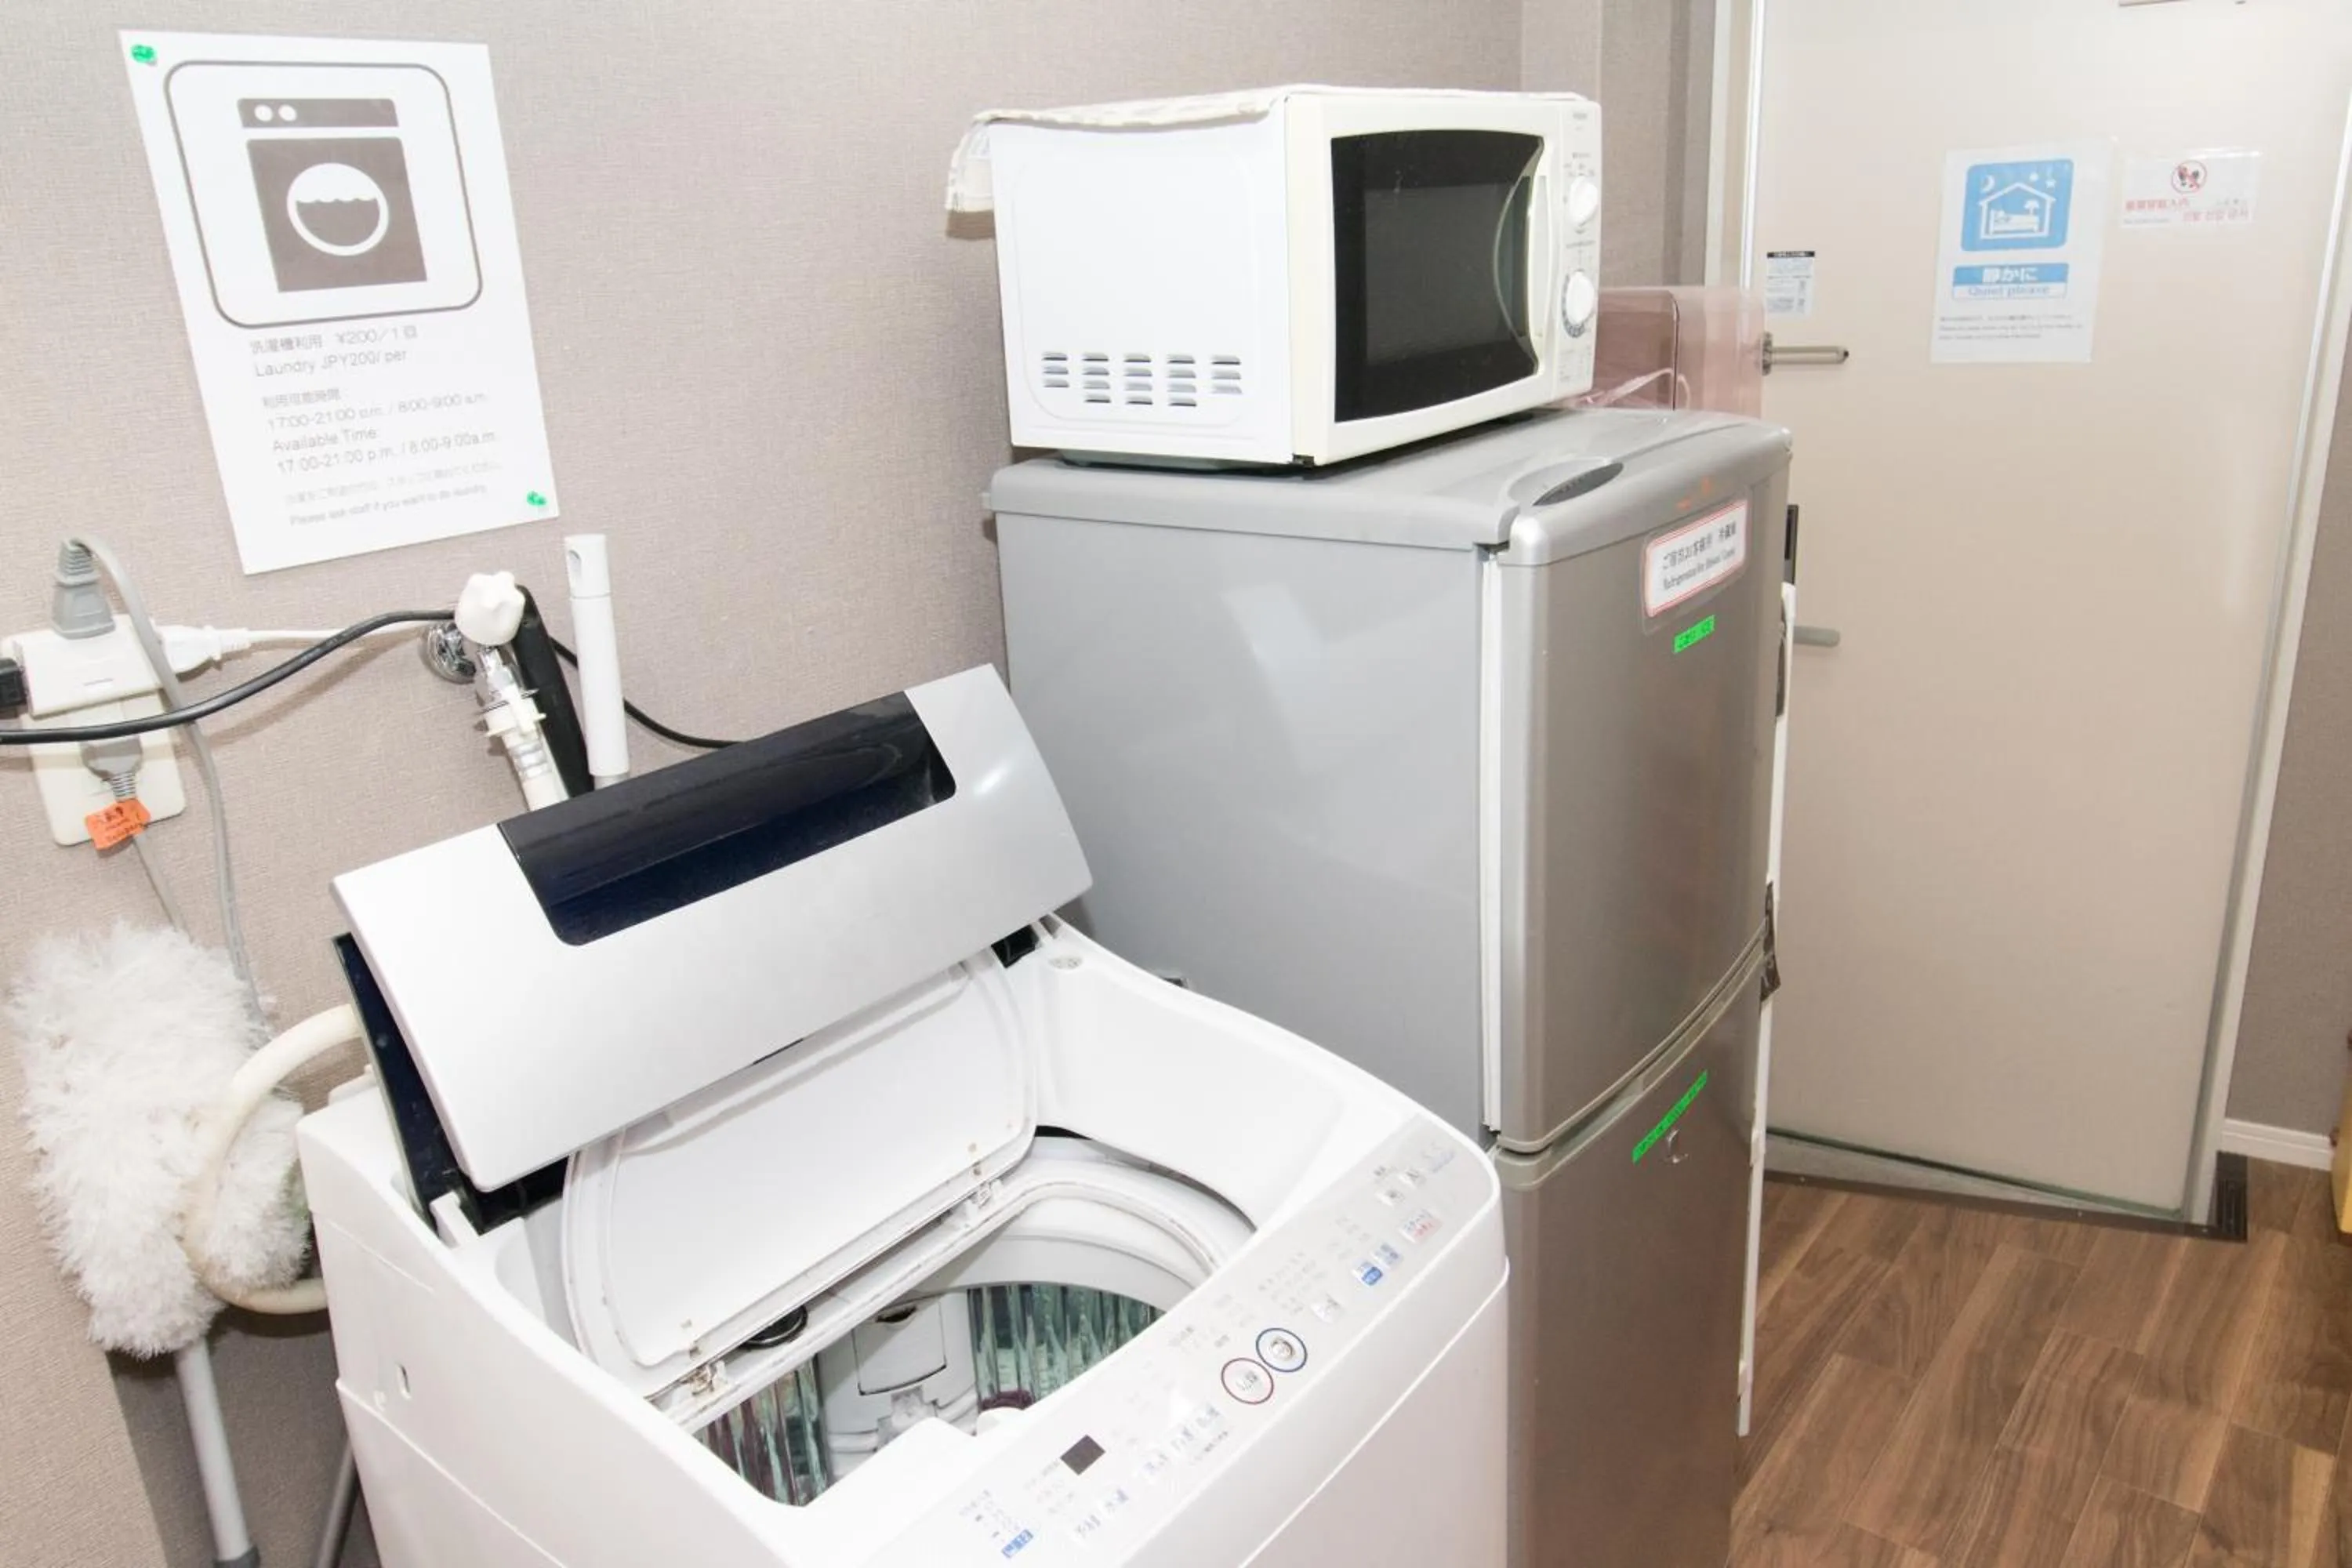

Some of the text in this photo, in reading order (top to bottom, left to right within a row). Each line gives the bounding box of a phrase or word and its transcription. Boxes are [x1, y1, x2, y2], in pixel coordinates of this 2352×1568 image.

[1983, 267, 2039, 284] 静かに
[254, 358, 315, 378] Laundry
[385, 350, 408, 363] per
[273, 427, 378, 452] Available Time
